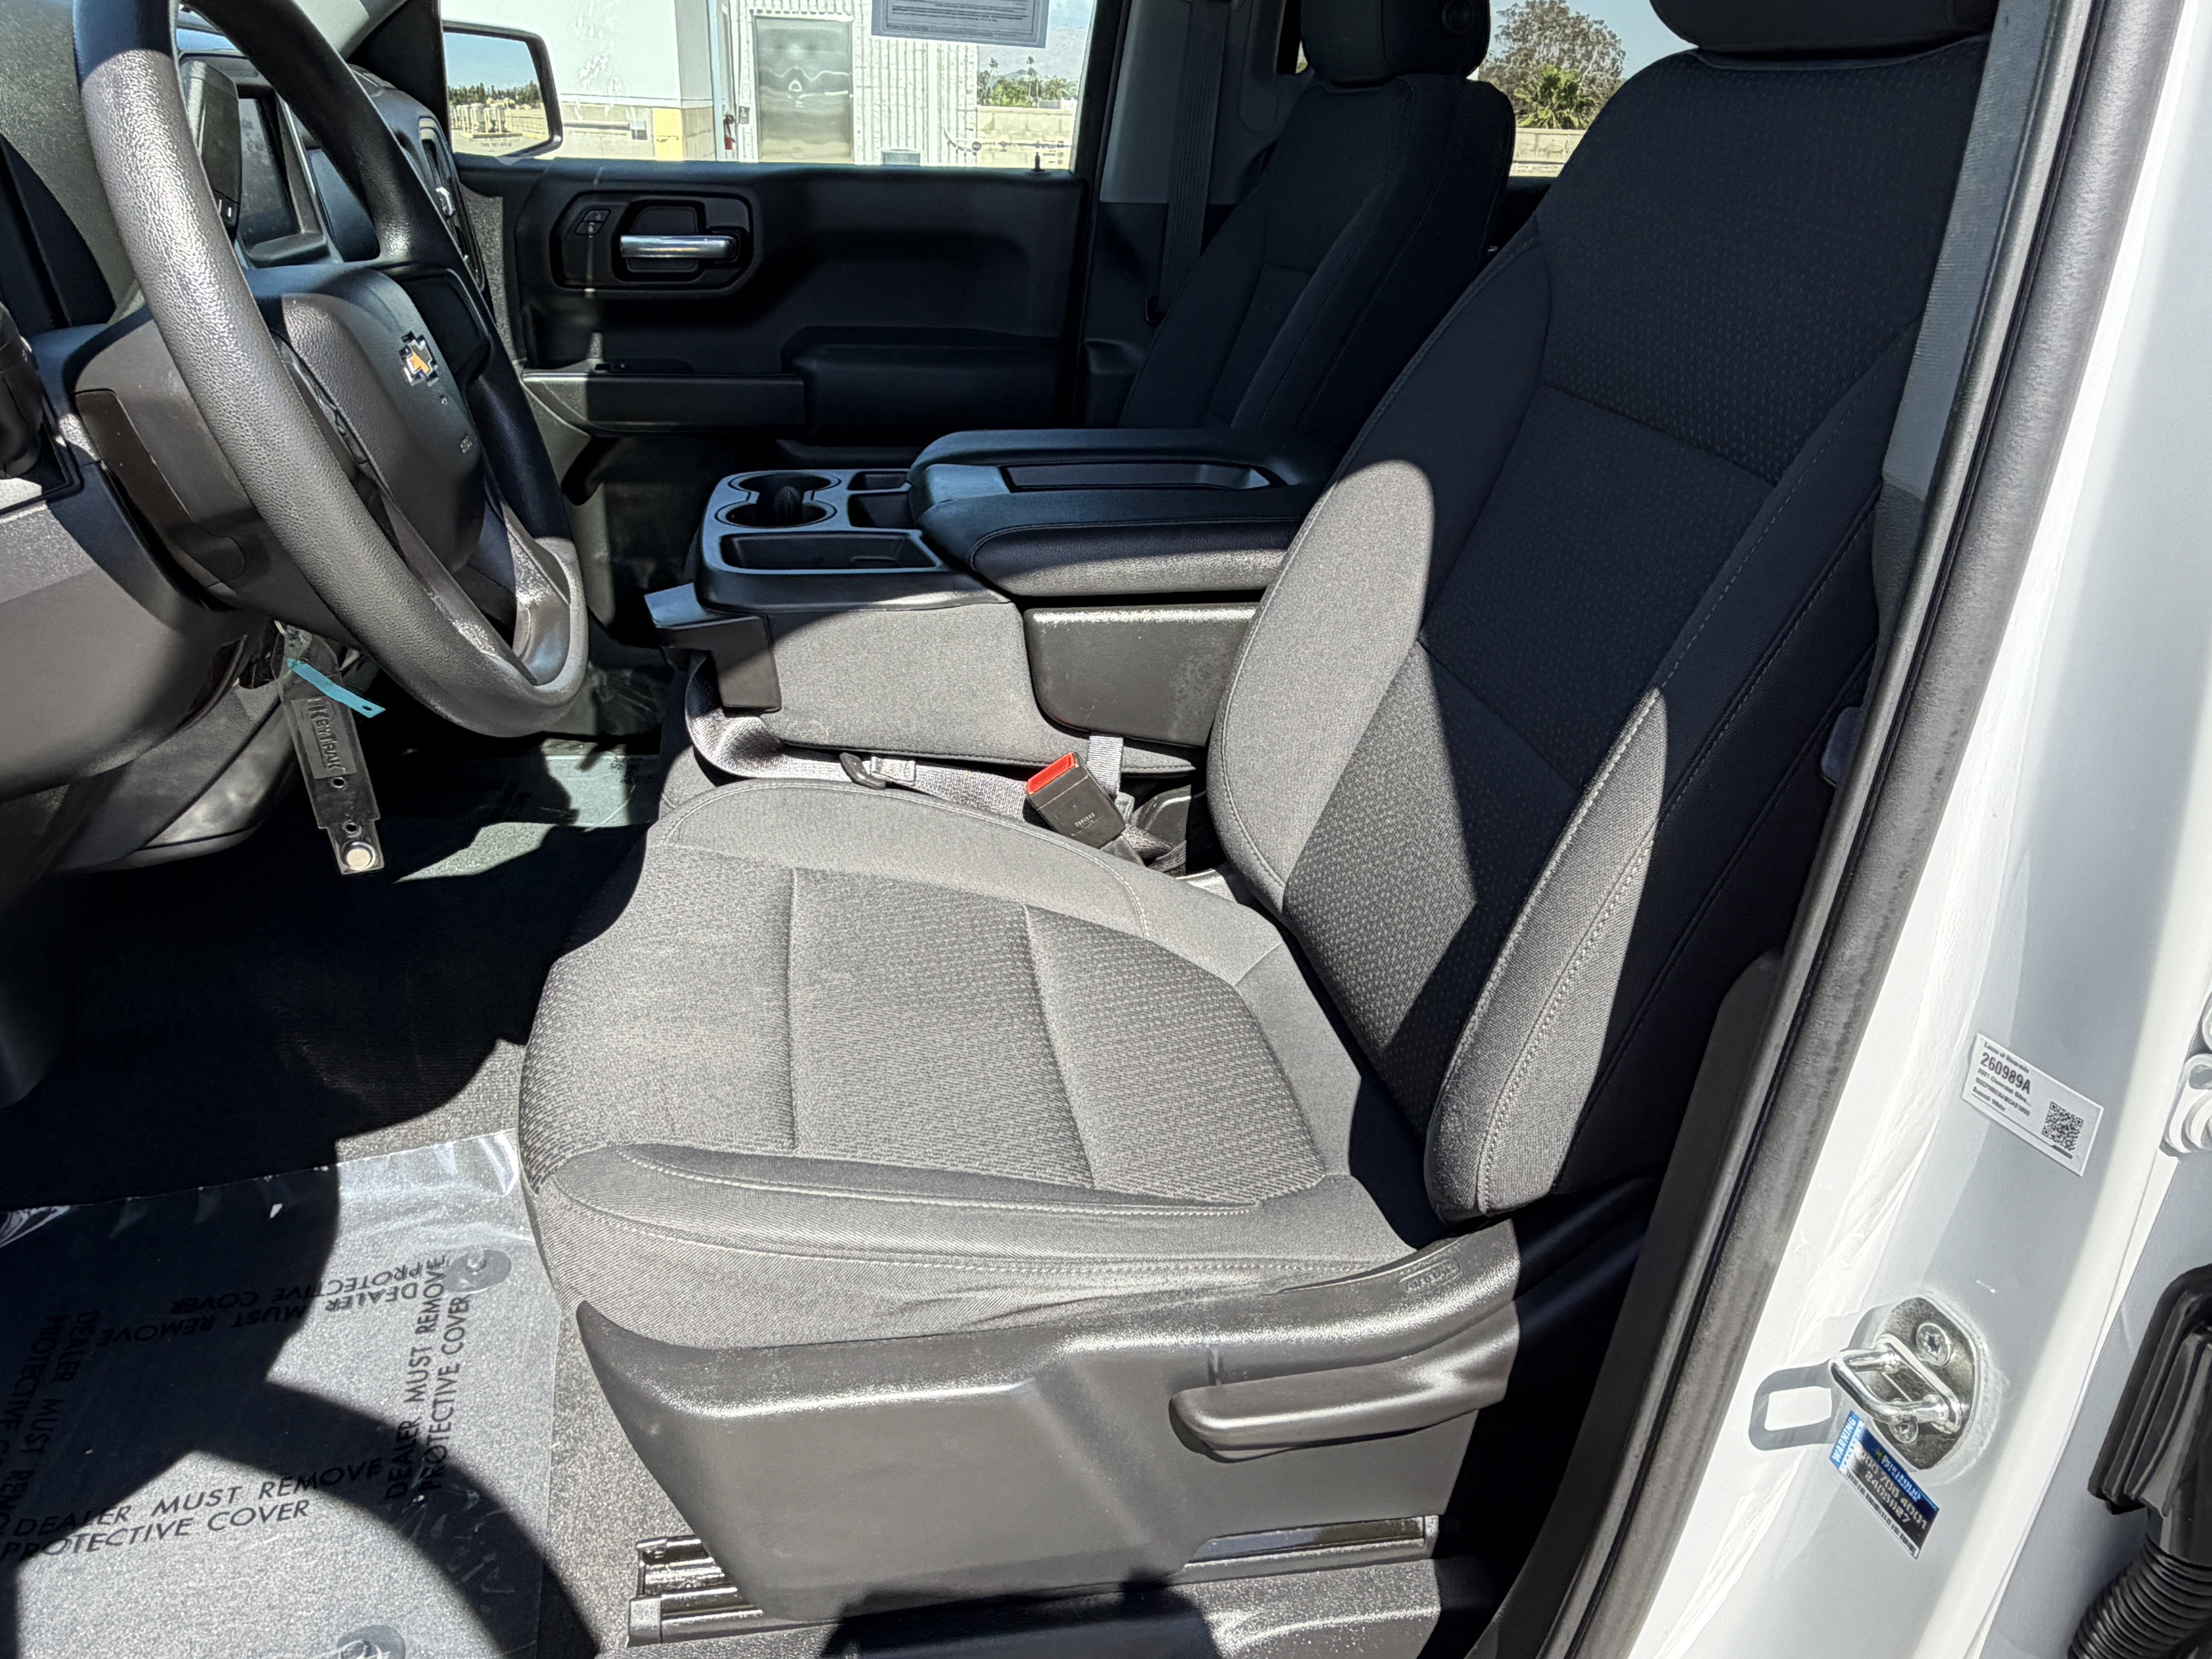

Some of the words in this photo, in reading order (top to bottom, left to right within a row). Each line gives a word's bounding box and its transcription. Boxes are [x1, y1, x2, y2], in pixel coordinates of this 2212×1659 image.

[1981, 1052, 2030, 1094] 260989A
[170, 1290, 259, 1315] COVER
[271, 1261, 422, 1303] PROTECTIVE
[325, 1283, 417, 1312] DEALER
[415, 1255, 447, 1335] REMOVE
[97, 1316, 215, 1347] REMOVE
[232, 1305, 307, 1328] MUST
[51, 1310, 100, 1382] DEALER
[404, 1345, 432, 1403] MUST
[419, 1362, 460, 1492] PROTECTIVE
[441, 1293, 470, 1355] COVER
[21, 1398, 64, 1455] MUST
[1832, 1416, 1857, 1462] WARNING
[385, 1416, 422, 1500] DEALER
[14, 1505, 132, 1536] DEALER
[150, 1486, 243, 1517] MUST
[258, 1456, 383, 1500] REMOVE
[0, 1518, 194, 1561] PROTECTIVE
[207, 1500, 310, 1531] COVER
